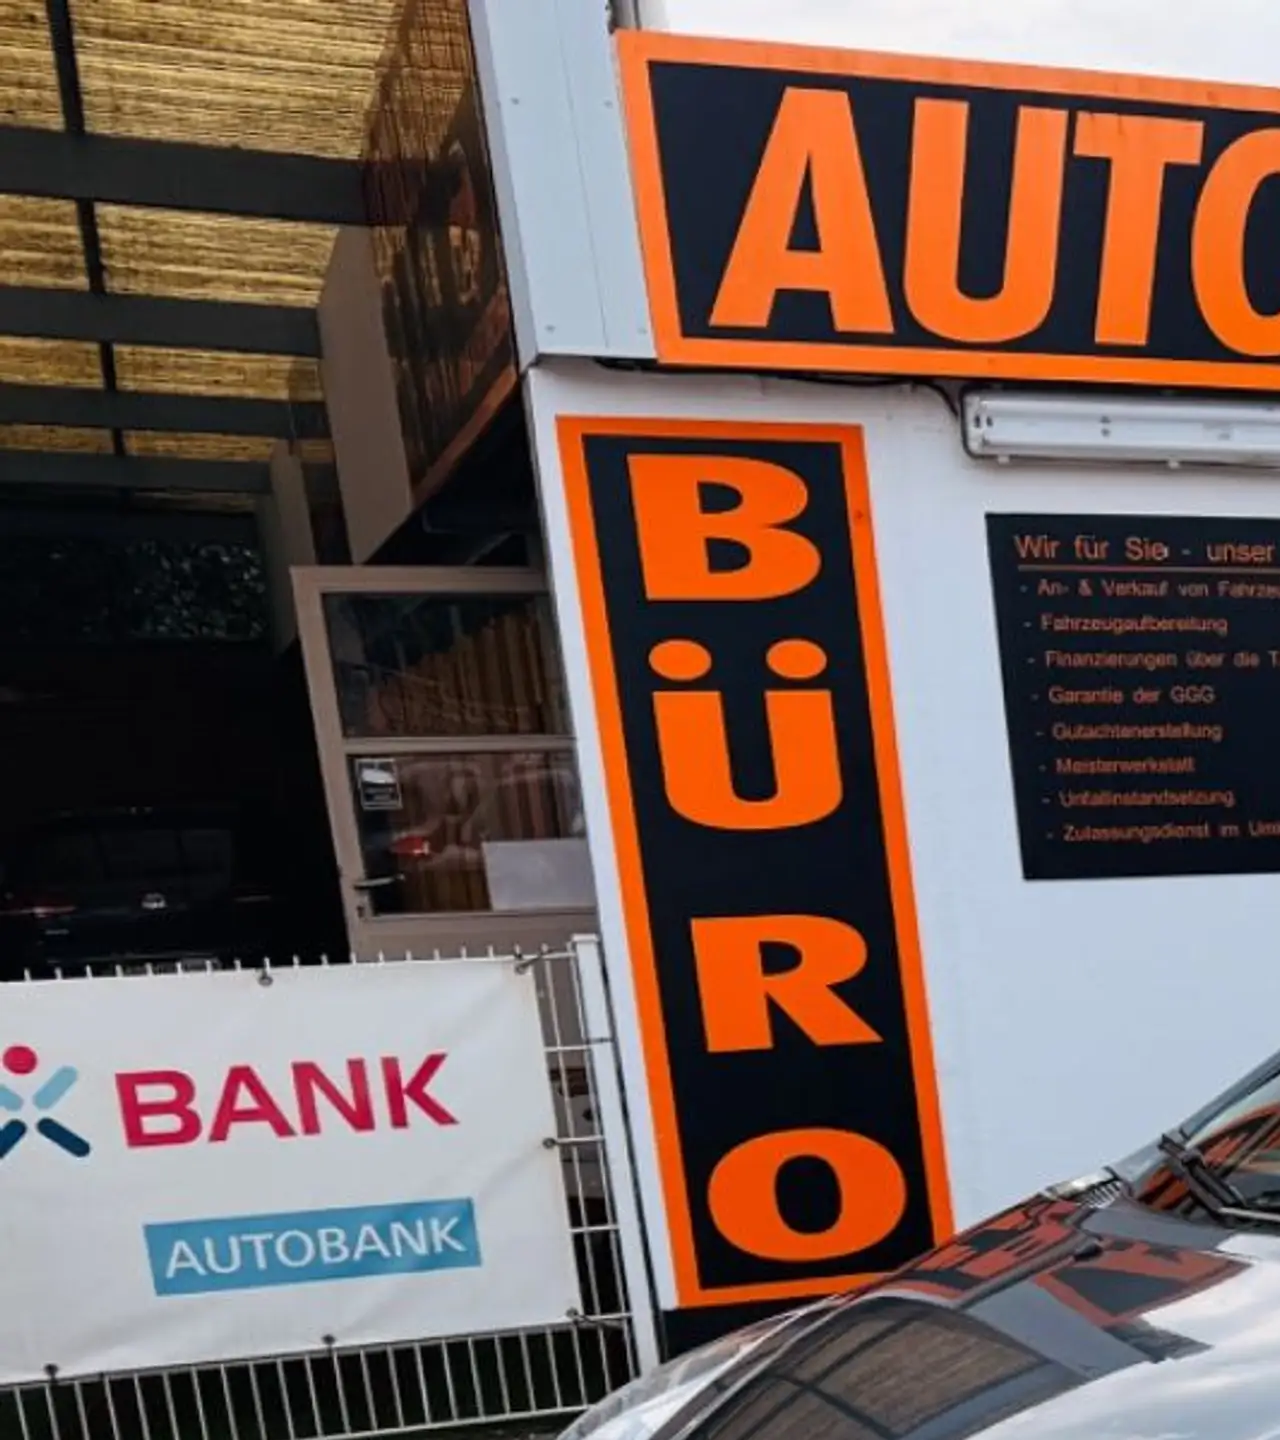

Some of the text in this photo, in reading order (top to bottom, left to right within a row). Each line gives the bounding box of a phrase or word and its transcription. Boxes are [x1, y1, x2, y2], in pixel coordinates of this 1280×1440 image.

[1013, 534, 1060, 559] Wir
[1073, 534, 1110, 560] für
[1124, 536, 1169, 561] Sie
[1206, 541, 1276, 563] unser
[1037, 578, 1069, 597] An-
[1078, 579, 1093, 597] &
[1101, 579, 1170, 597] Verkauf
[1178, 582, 1209, 597] von
[1040, 613, 1228, 637] Fahrzeugaufbereitung
[1045, 650, 1177, 671] Finanzierungen
[1186, 650, 1225, 668] über
[1233, 650, 1261, 668] die
[1048, 685, 1216, 704] Garantie der GGG
[1052, 722, 1224, 743] Gutachtenerstellung
[1062, 822, 1211, 843] Zulassungsdienst
[626, 452, 907, 1262] BÜRO
[115, 1052, 459, 1149] BANK
[164, 1214, 468, 1280] AUTOBANK
